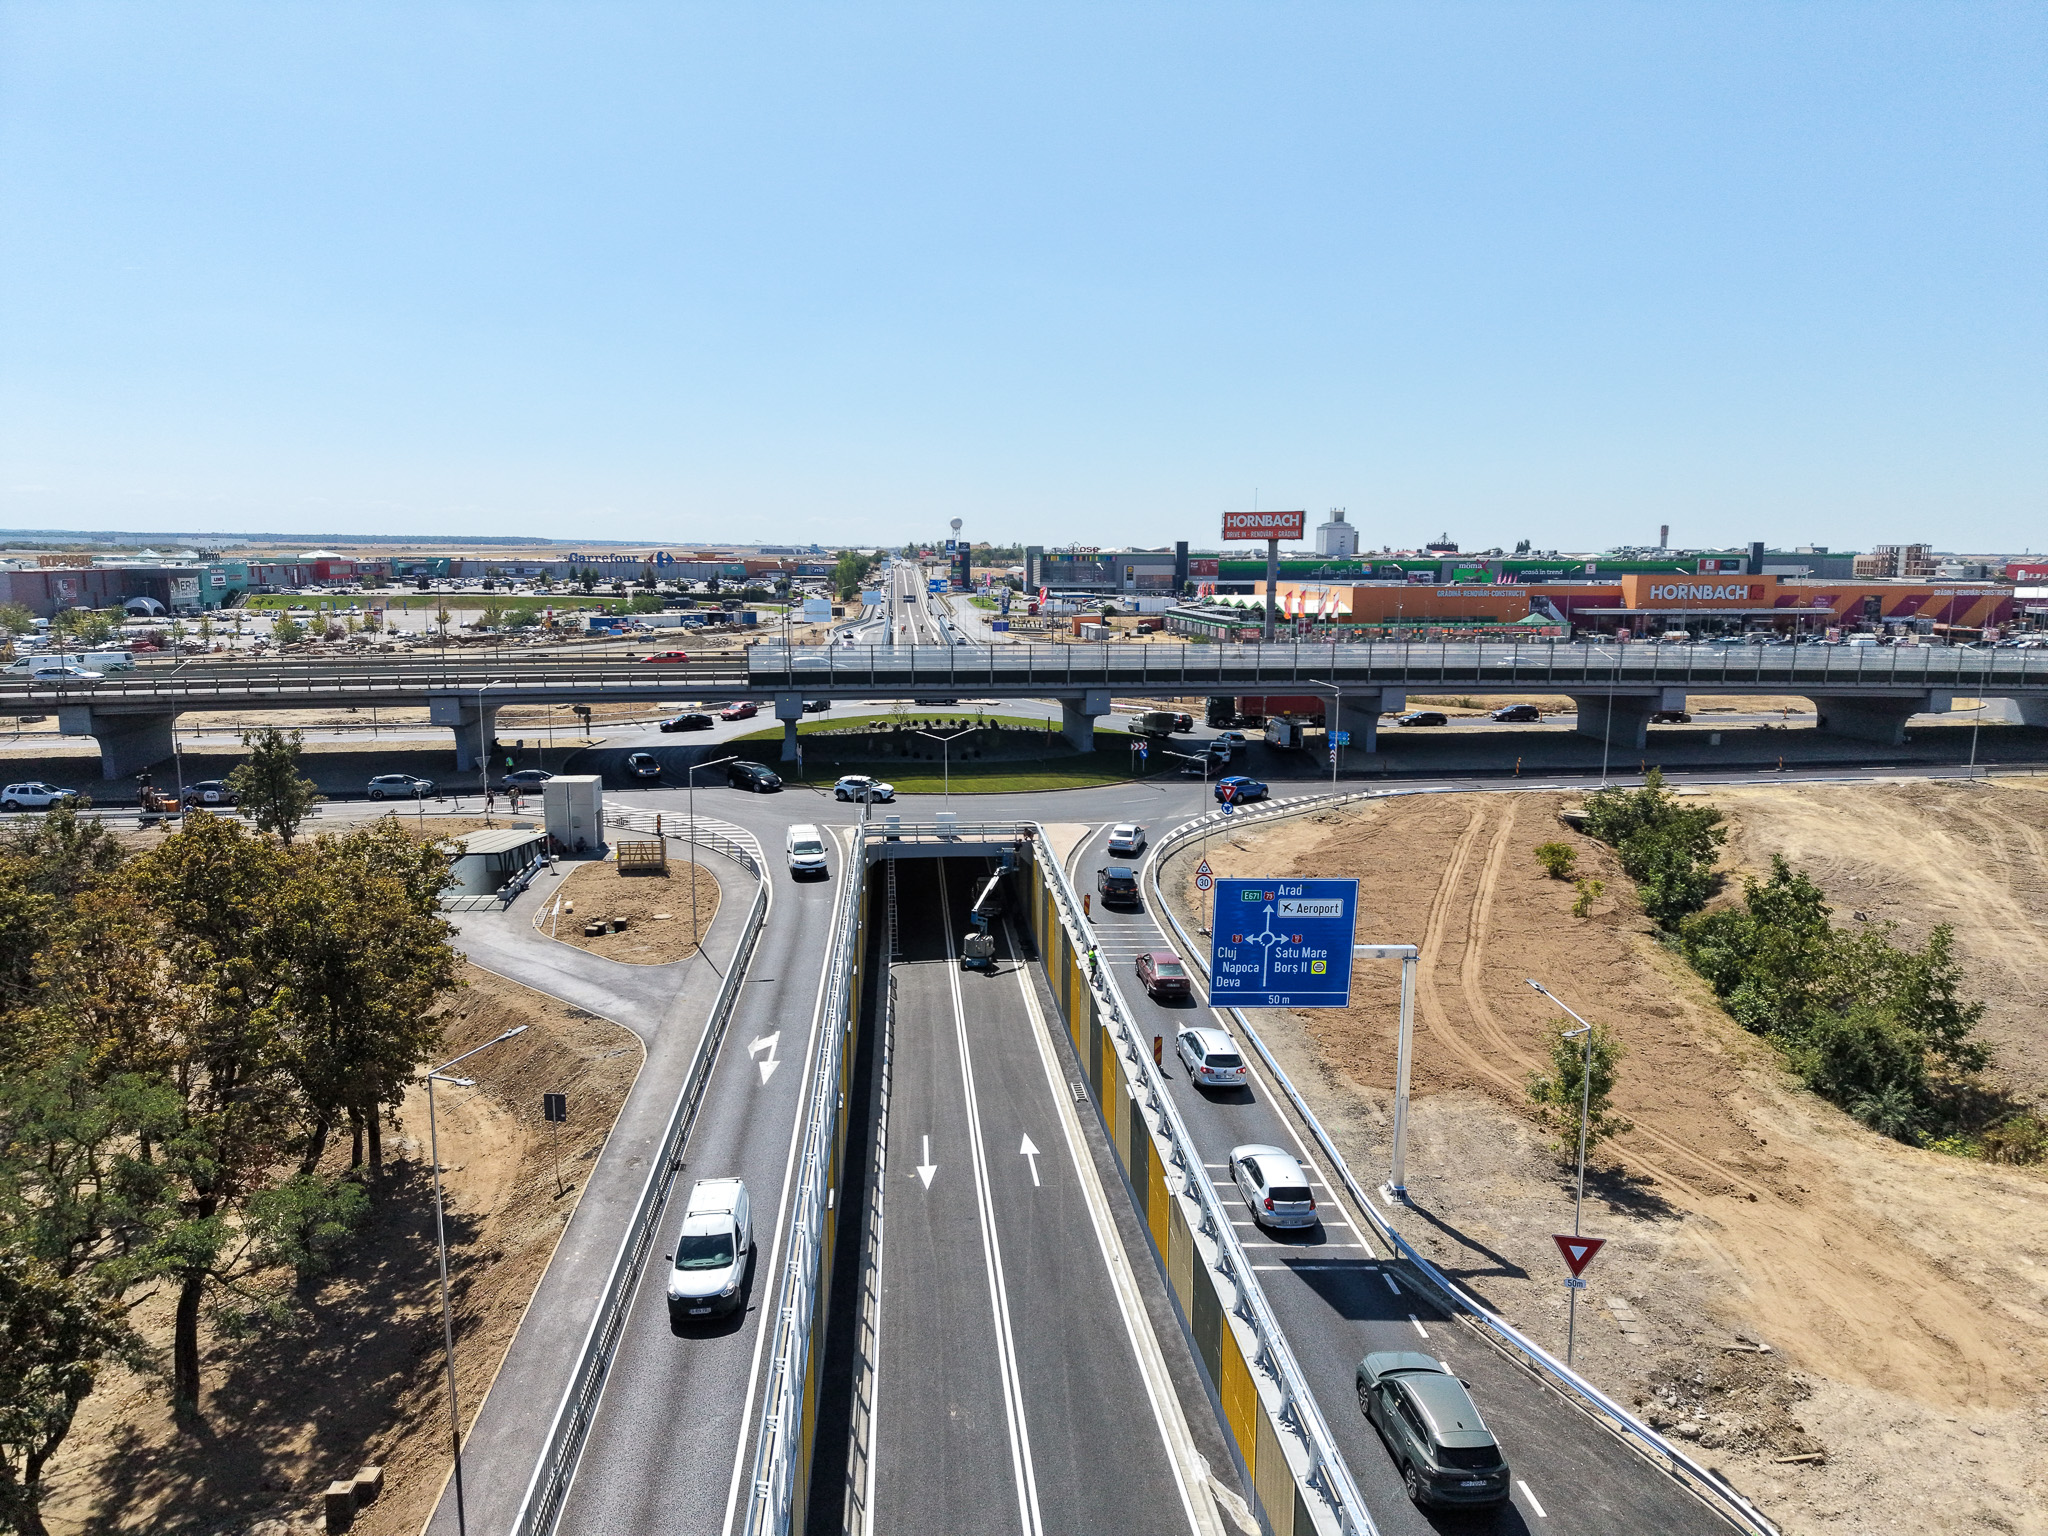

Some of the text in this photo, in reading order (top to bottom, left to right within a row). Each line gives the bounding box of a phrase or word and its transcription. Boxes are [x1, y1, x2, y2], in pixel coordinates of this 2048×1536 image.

[1227, 514, 1299, 527] HORNBACH
[569, 553, 639, 563] Carrefour
[1650, 584, 1748, 600] HORNBACH
[1199, 878, 1209, 887] 30
[1244, 892, 1260, 900] E671
[1278, 884, 1303, 896] Arad
[1296, 903, 1339, 916] Aeroport
[1217, 946, 1237, 961] Cluj
[1275, 947, 1327, 958] Satu Mare
[1222, 961, 1260, 975] Napoca
[1274, 961, 1308, 974] Borș II
[1216, 976, 1241, 987] Deva
[1268, 994, 1290, 1004] 50 m
